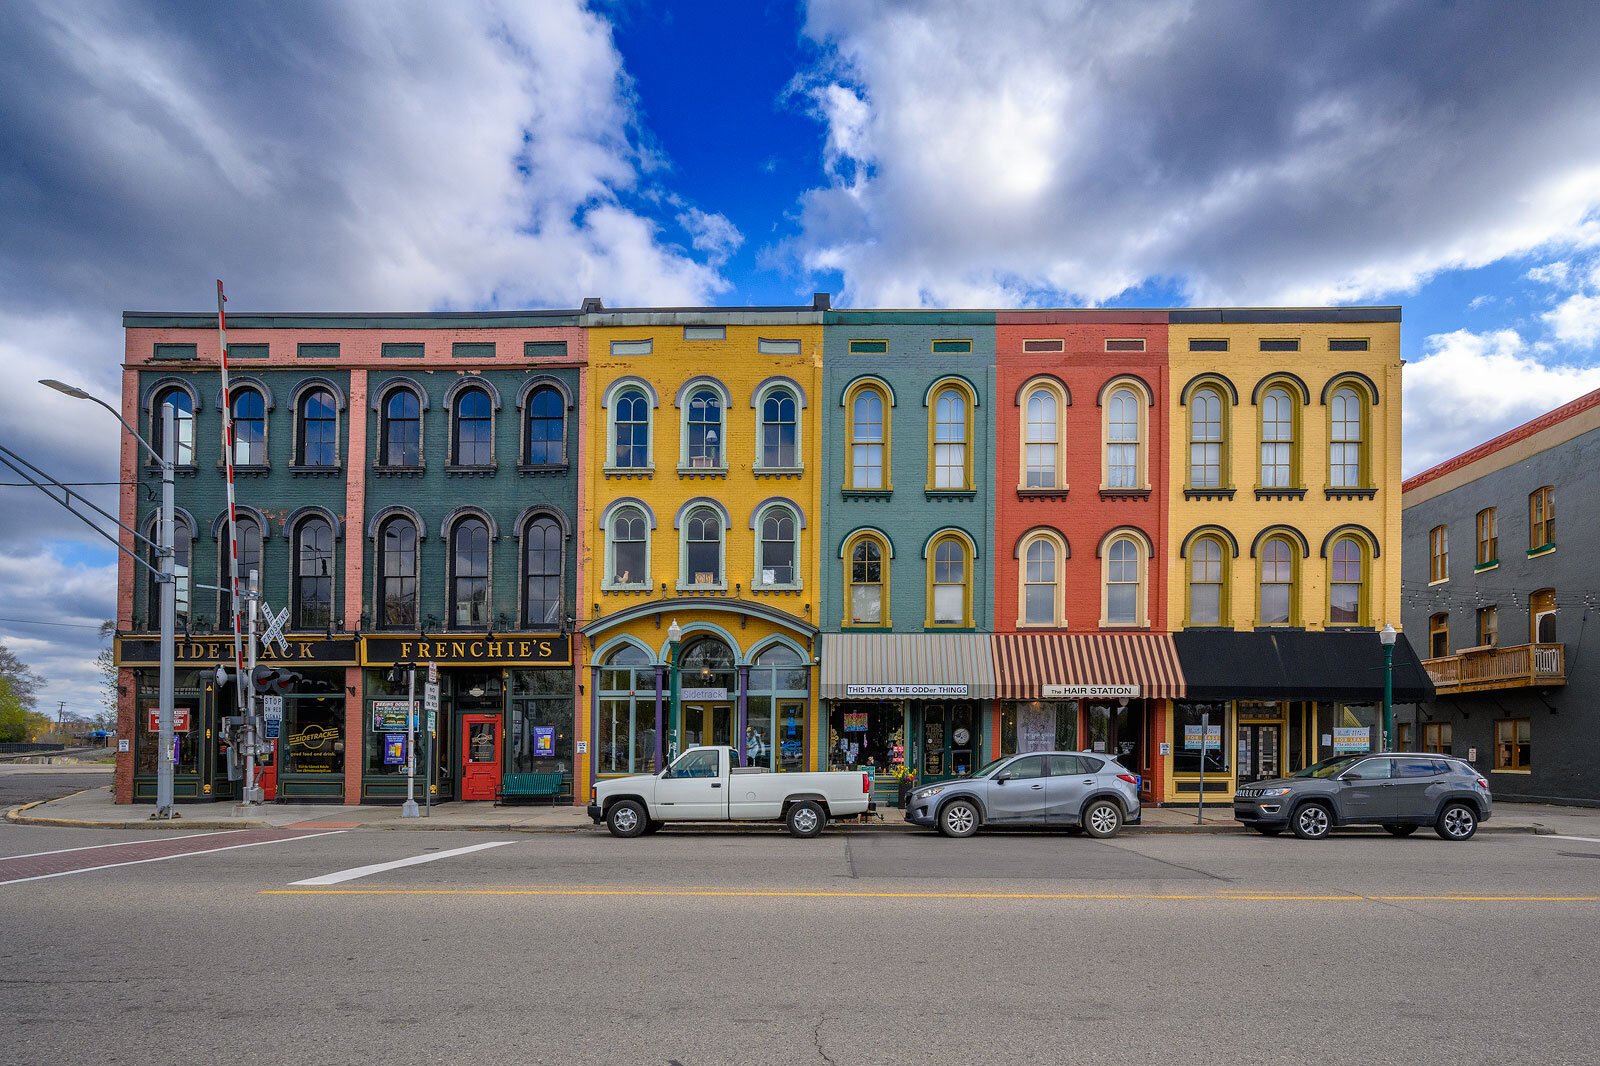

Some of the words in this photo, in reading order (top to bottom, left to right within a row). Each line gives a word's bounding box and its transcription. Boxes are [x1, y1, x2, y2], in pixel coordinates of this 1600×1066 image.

[263, 609, 289, 645] CROSSING
[401, 640, 552, 658] FRENCHIE'S
[683, 690, 724, 699] Sidetrack
[264, 697, 282, 705] STOP
[295, 731, 333, 742] SIDETRACK
